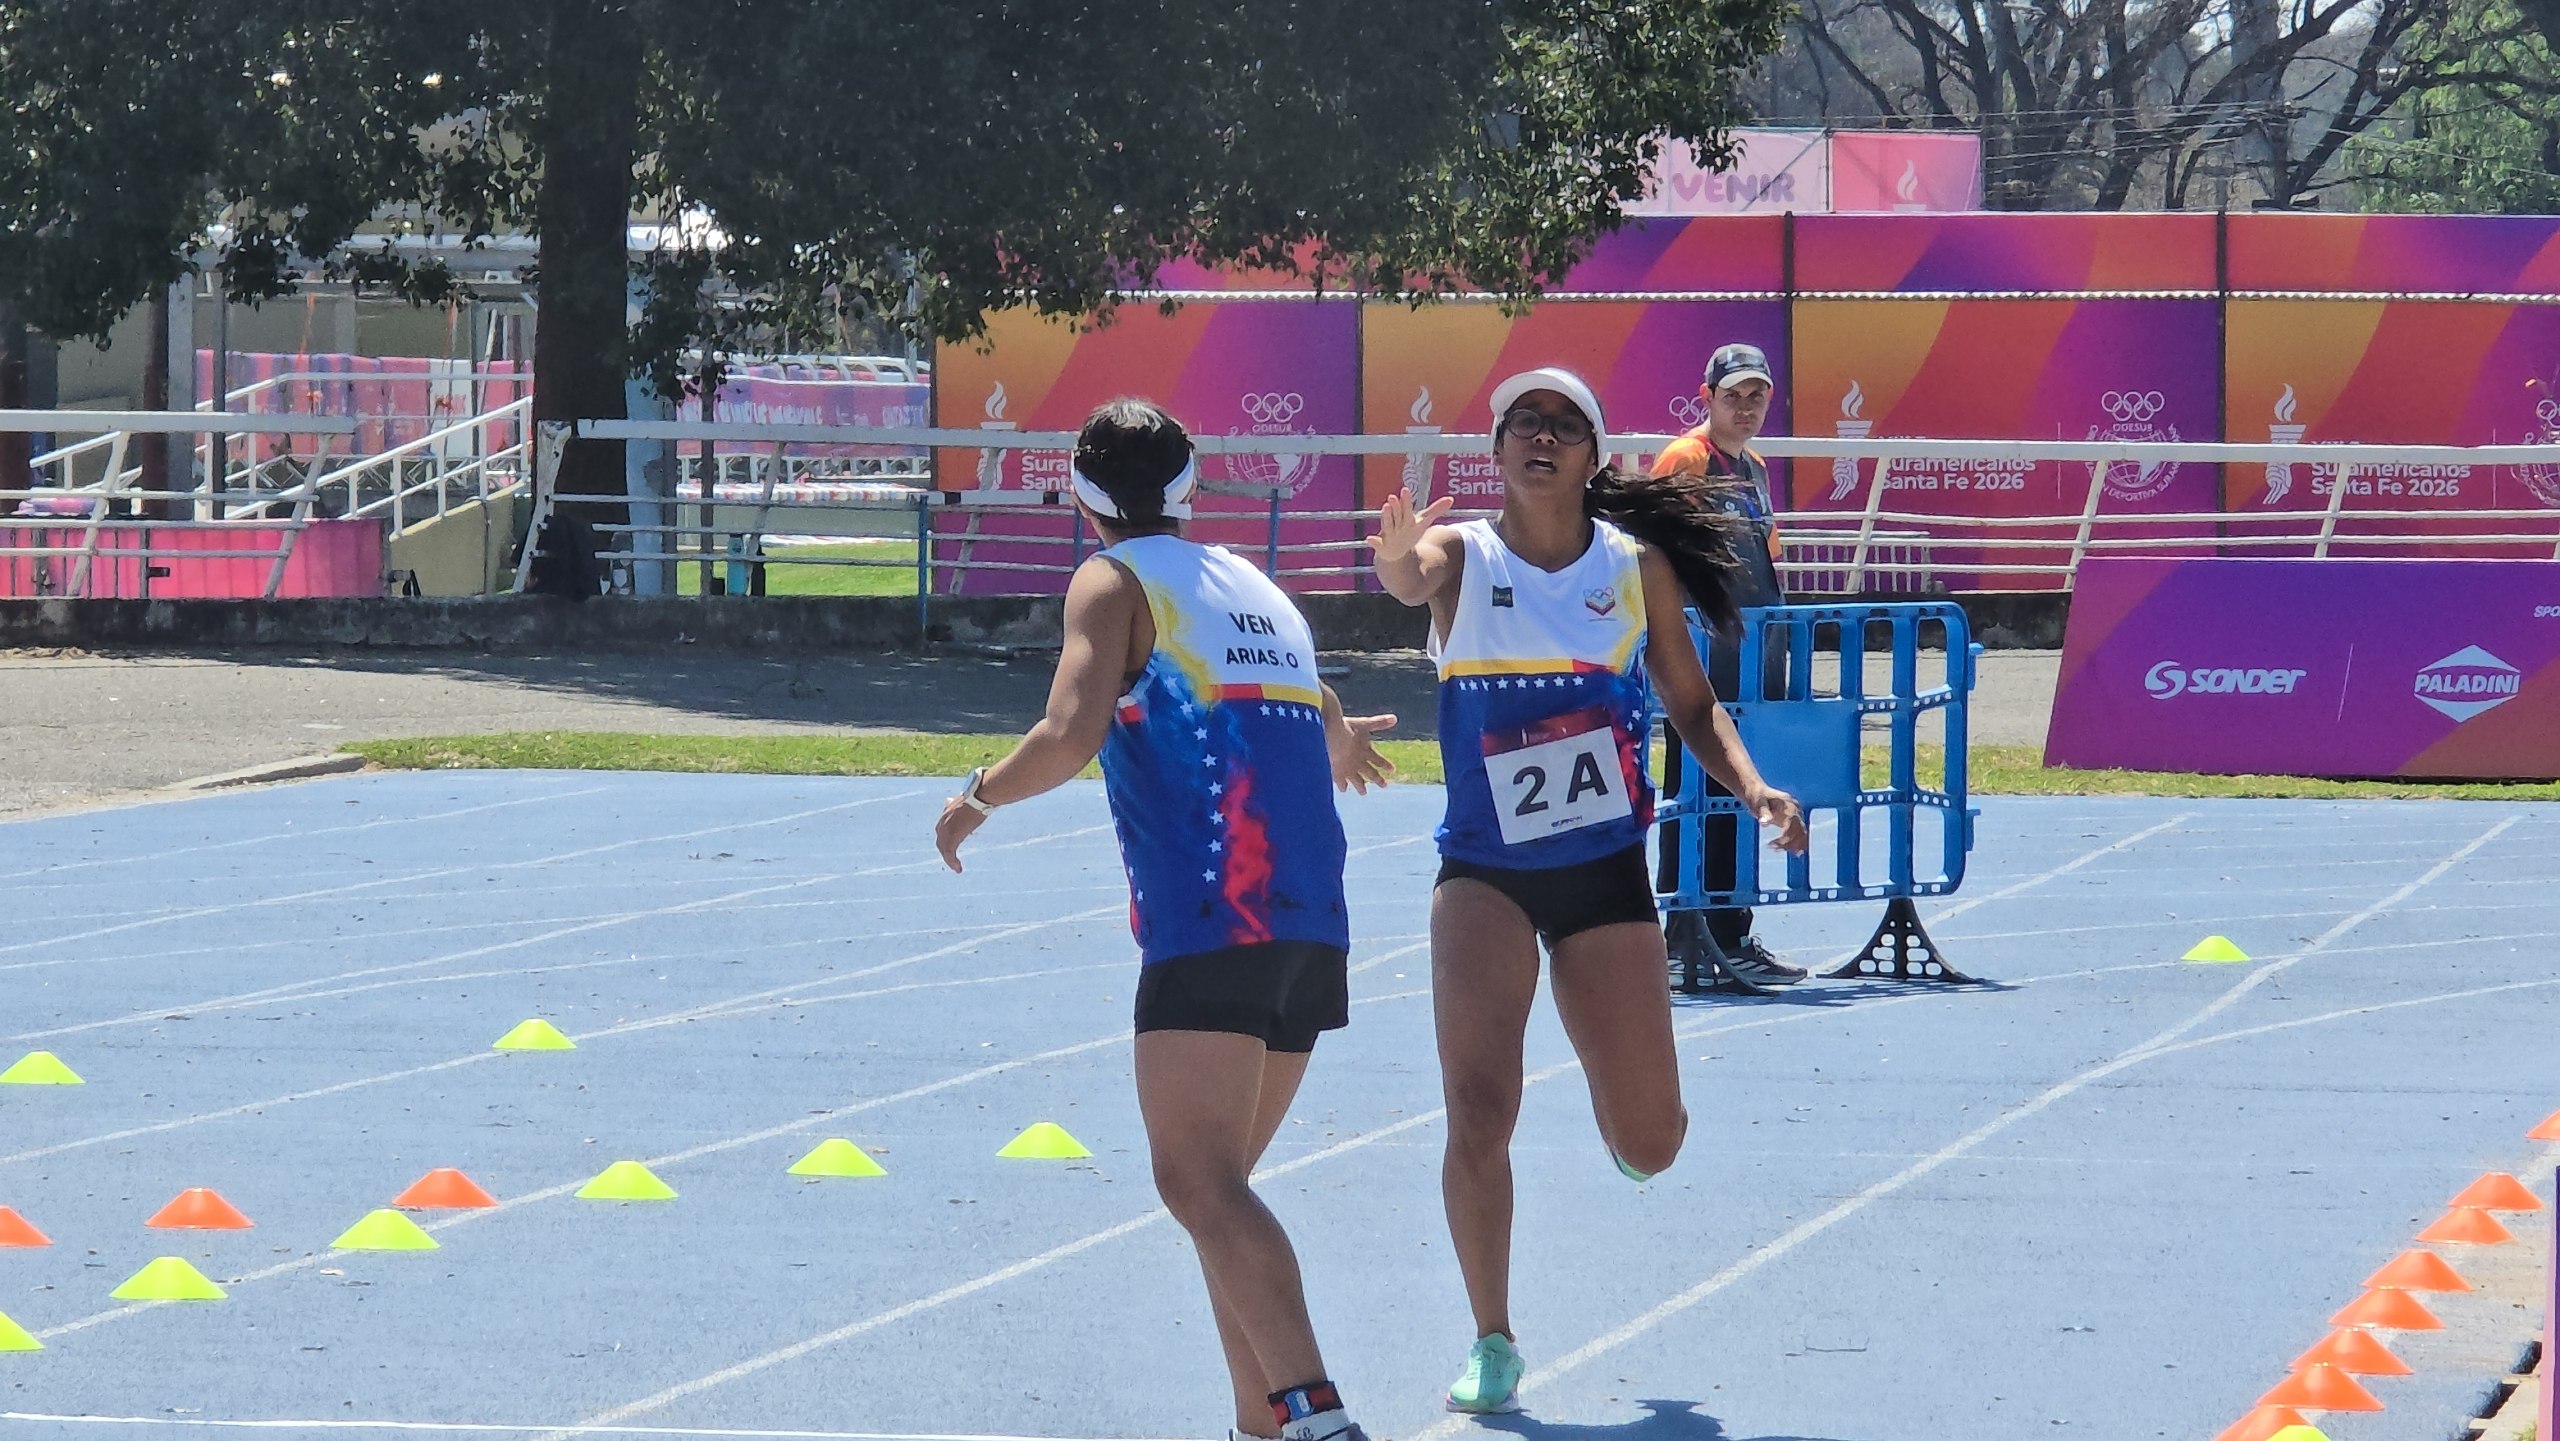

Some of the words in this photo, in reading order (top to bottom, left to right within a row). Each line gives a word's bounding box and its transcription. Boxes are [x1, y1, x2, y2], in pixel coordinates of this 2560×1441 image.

[1672, 172, 1796, 203] VENIR
[2113, 423, 2153, 432] ODESUR
[1887, 457, 2036, 471] uramericanos
[2311, 462, 2471, 478] Suamericanos
[1943, 473, 1970, 490] Fe
[1973, 473, 2025, 490] 2026
[2377, 479, 2404, 495] Fe
[2407, 479, 2460, 496] 2026
[1228, 612, 1276, 636] VEN
[1285, 652, 1299, 669] O
[2414, 673, 2521, 694] PALADINI
[1512, 765, 1549, 817] 2
[1566, 751, 1609, 805] A
